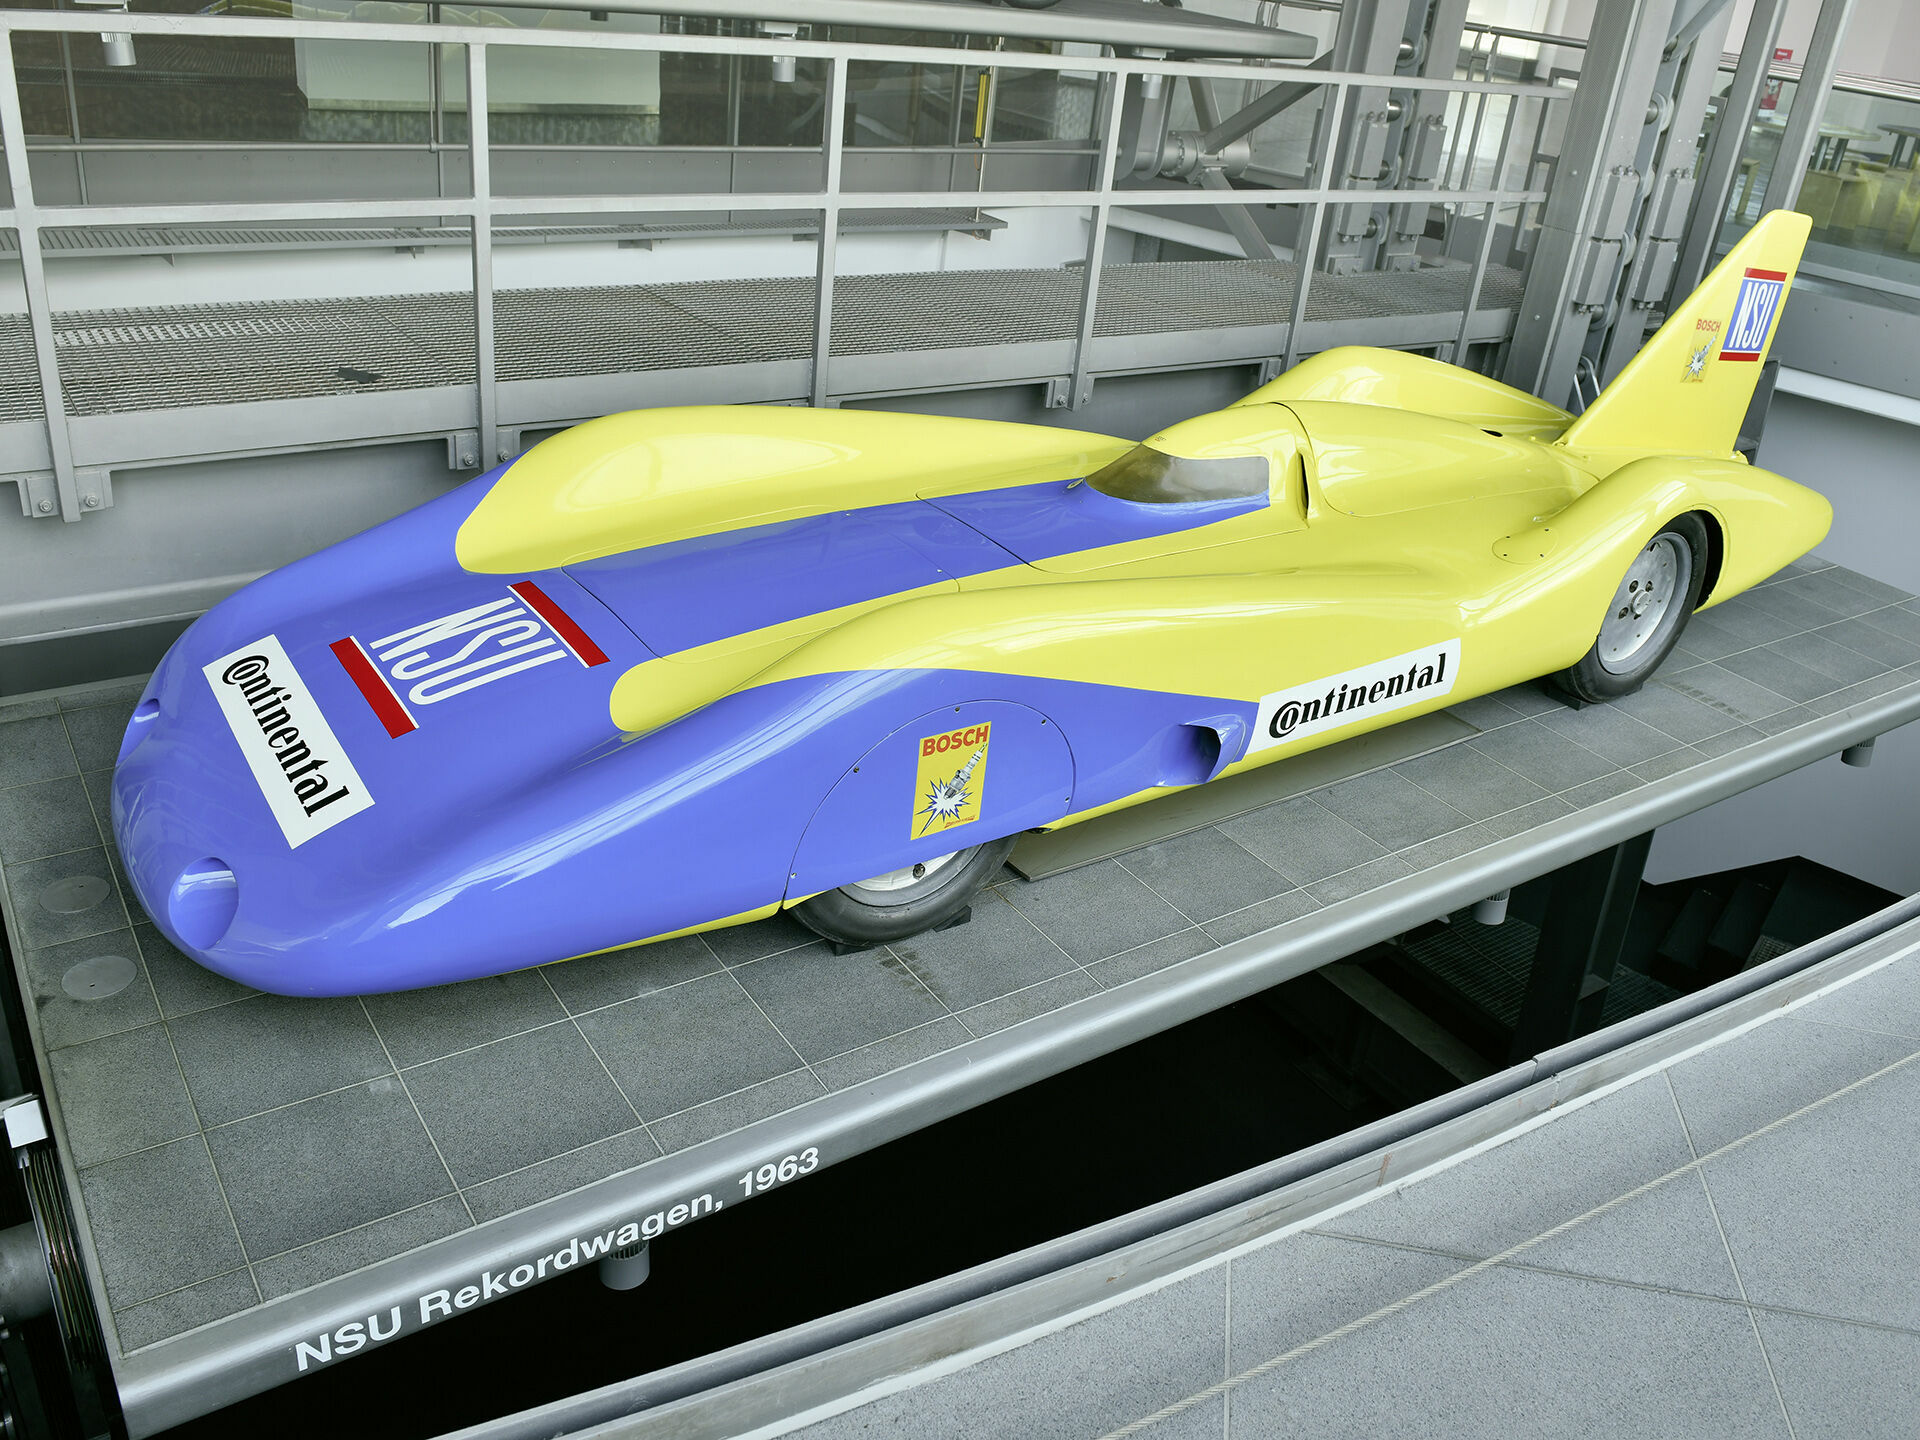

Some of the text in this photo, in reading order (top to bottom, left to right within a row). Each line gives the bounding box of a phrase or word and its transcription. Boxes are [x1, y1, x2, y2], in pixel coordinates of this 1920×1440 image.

[1696, 318, 1721, 332] BOSCH
[1728, 281, 1779, 349] NSU
[369, 596, 568, 706] NSU
[222, 654, 350, 818] Continental
[1269, 653, 1447, 738] Continental
[922, 725, 989, 757] BOSCH
[294, 1146, 819, 1372] NSU Rekordwagen, 1963
